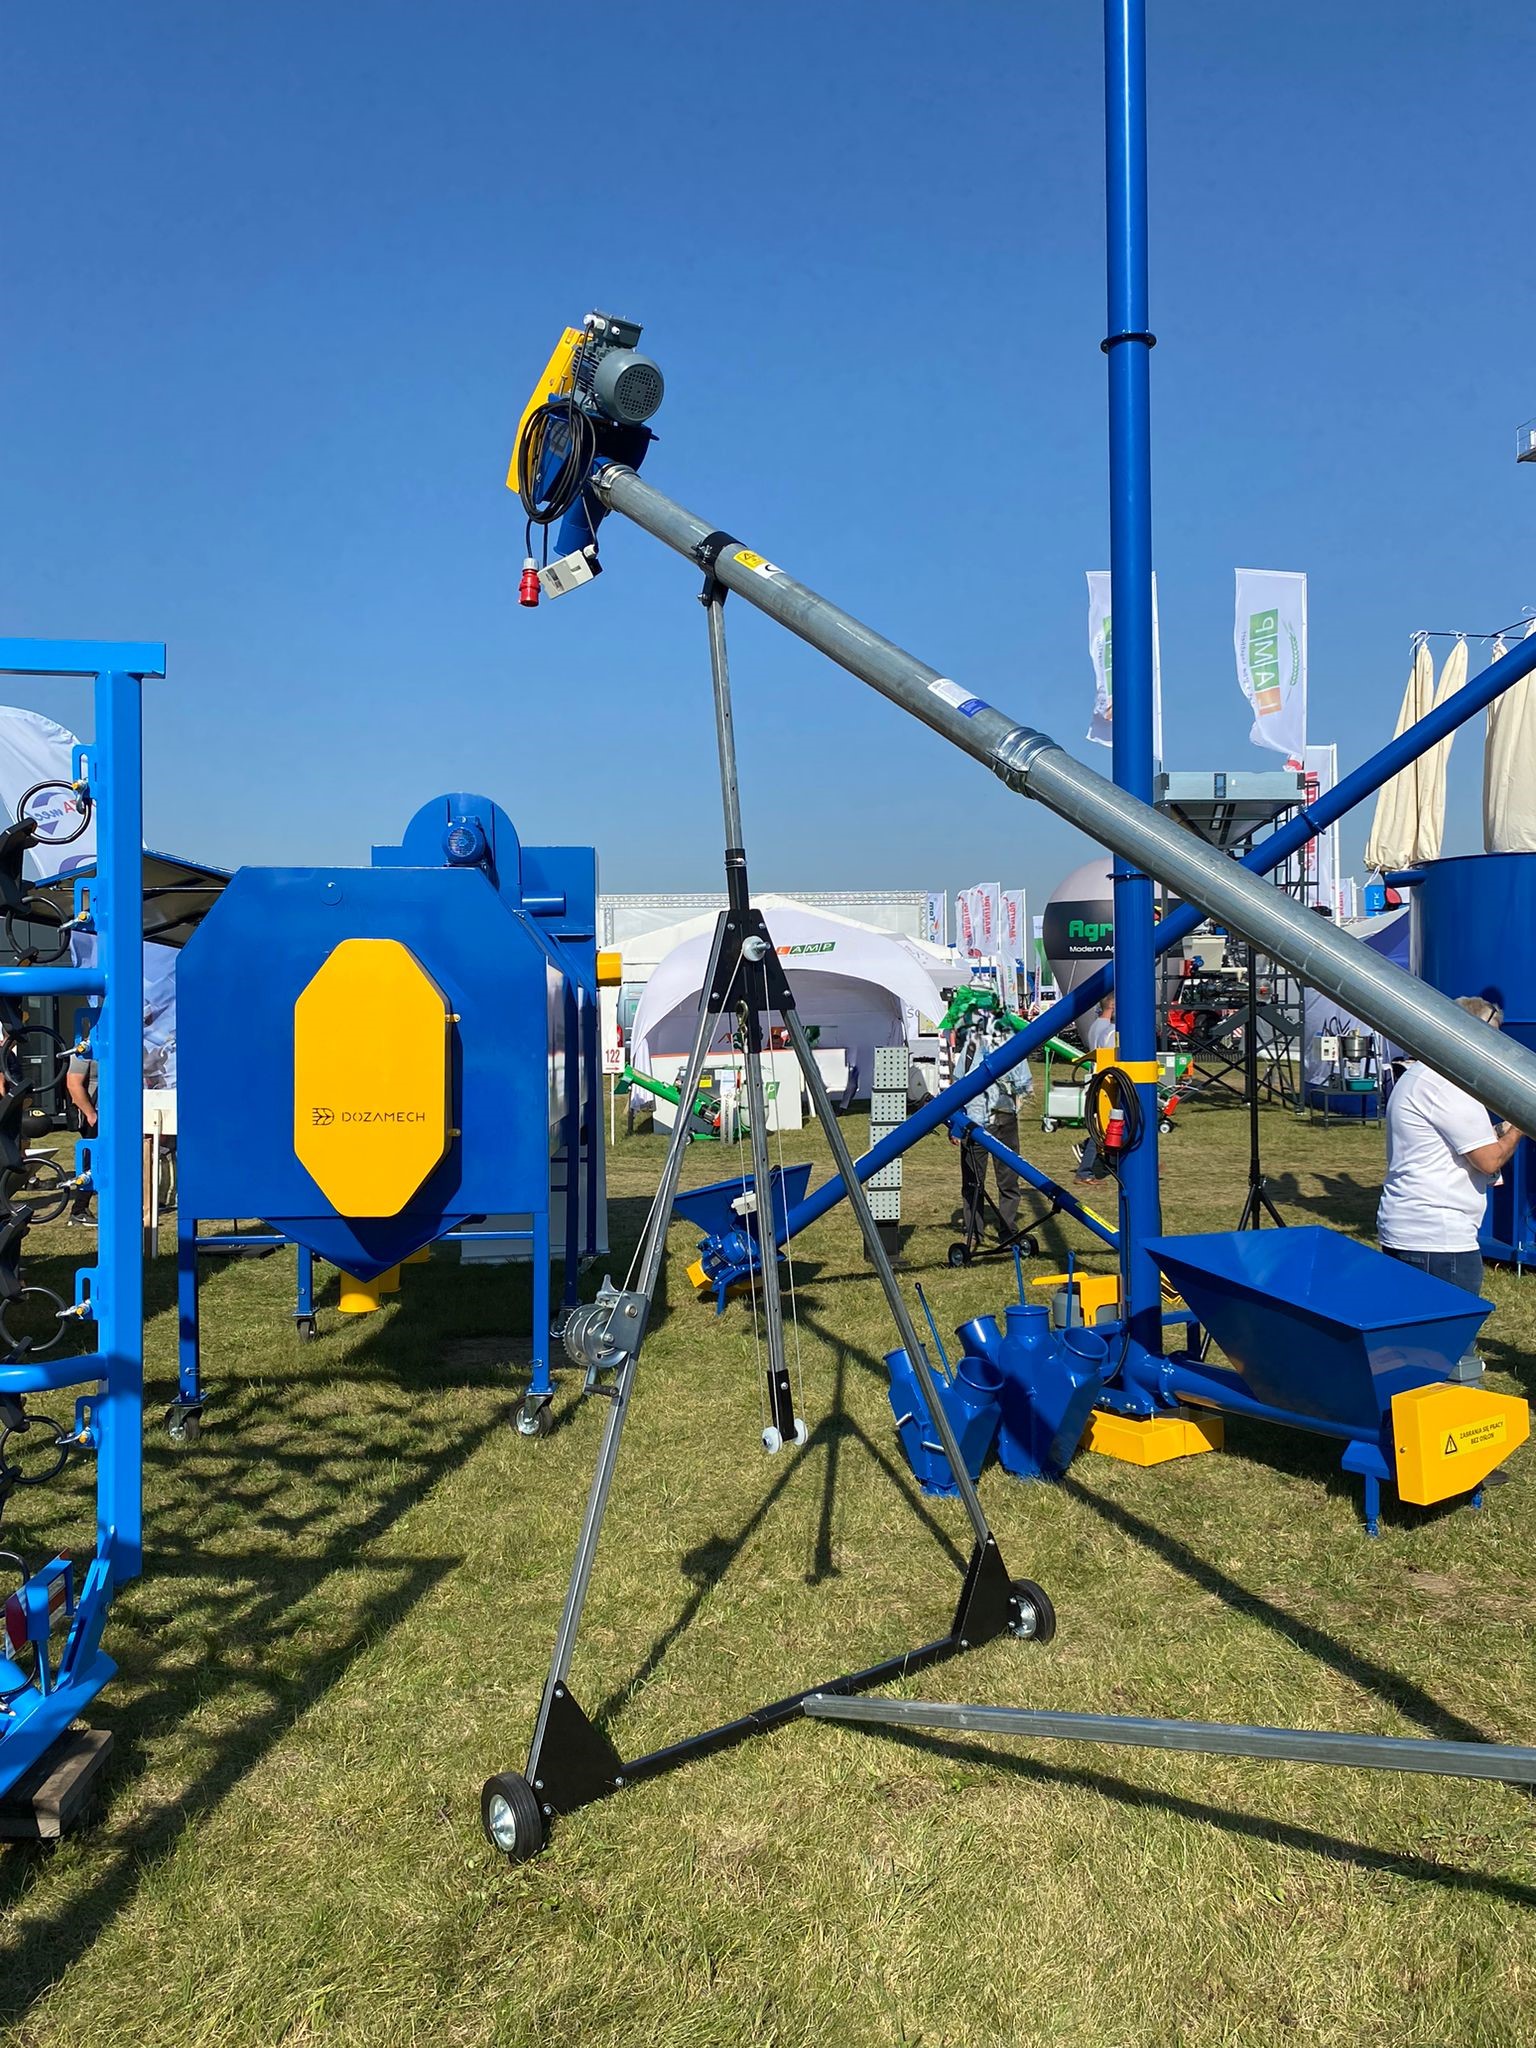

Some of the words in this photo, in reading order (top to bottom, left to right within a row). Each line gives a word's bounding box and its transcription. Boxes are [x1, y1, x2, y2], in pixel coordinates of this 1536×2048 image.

[777, 942, 835, 954] LAMP
[605, 1049, 621, 1063] 122
[341, 1111, 426, 1122] DOZAMECH
